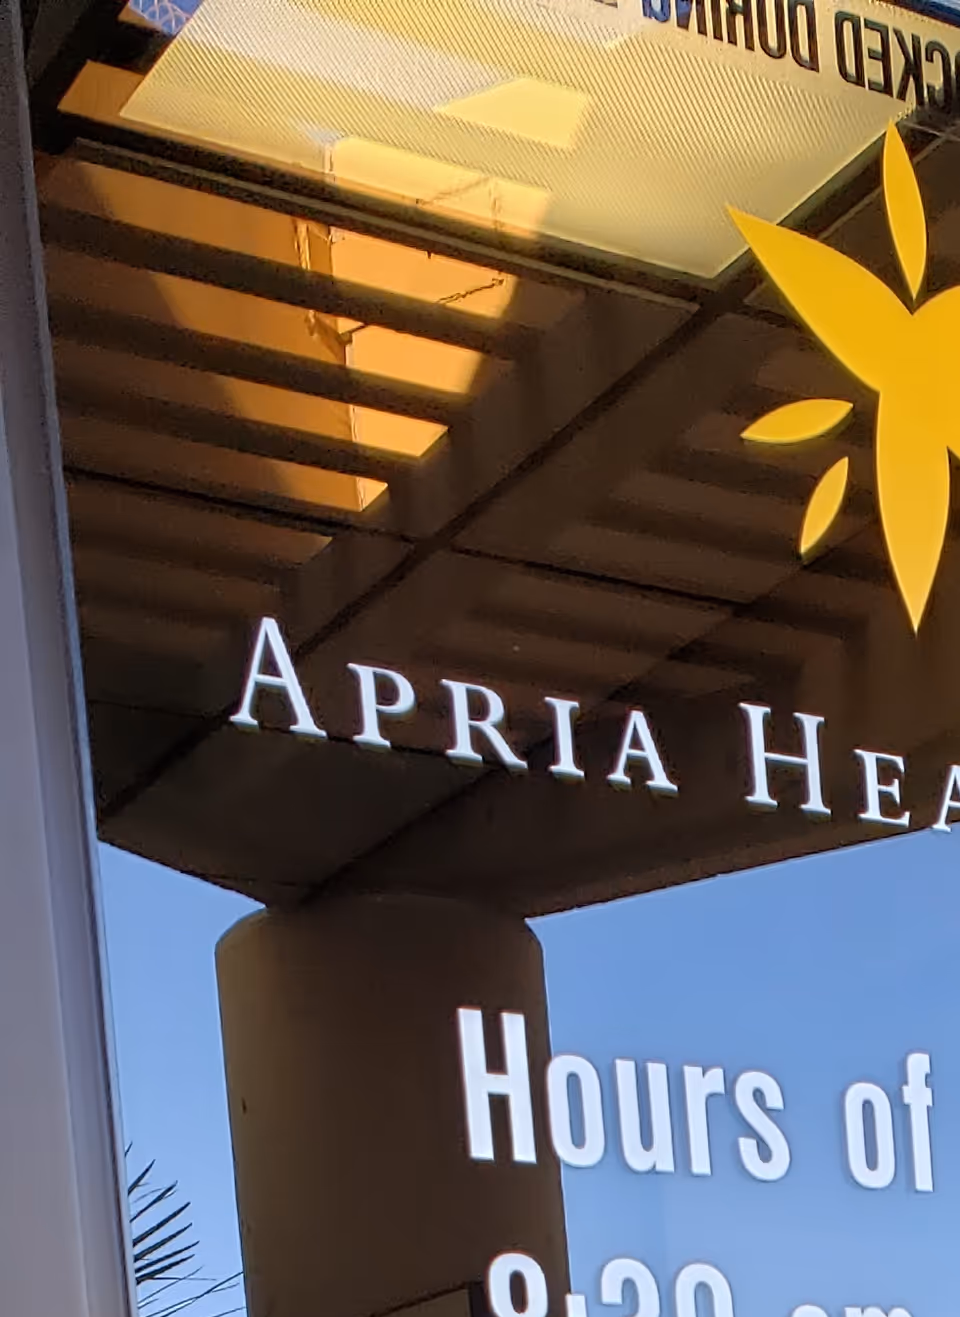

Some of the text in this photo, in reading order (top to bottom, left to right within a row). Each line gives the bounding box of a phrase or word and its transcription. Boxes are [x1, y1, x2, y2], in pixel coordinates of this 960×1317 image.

[229, 616, 679, 794] APRIA
[455, 1006, 793, 1183] Hours
[843, 1050, 936, 1193] of
